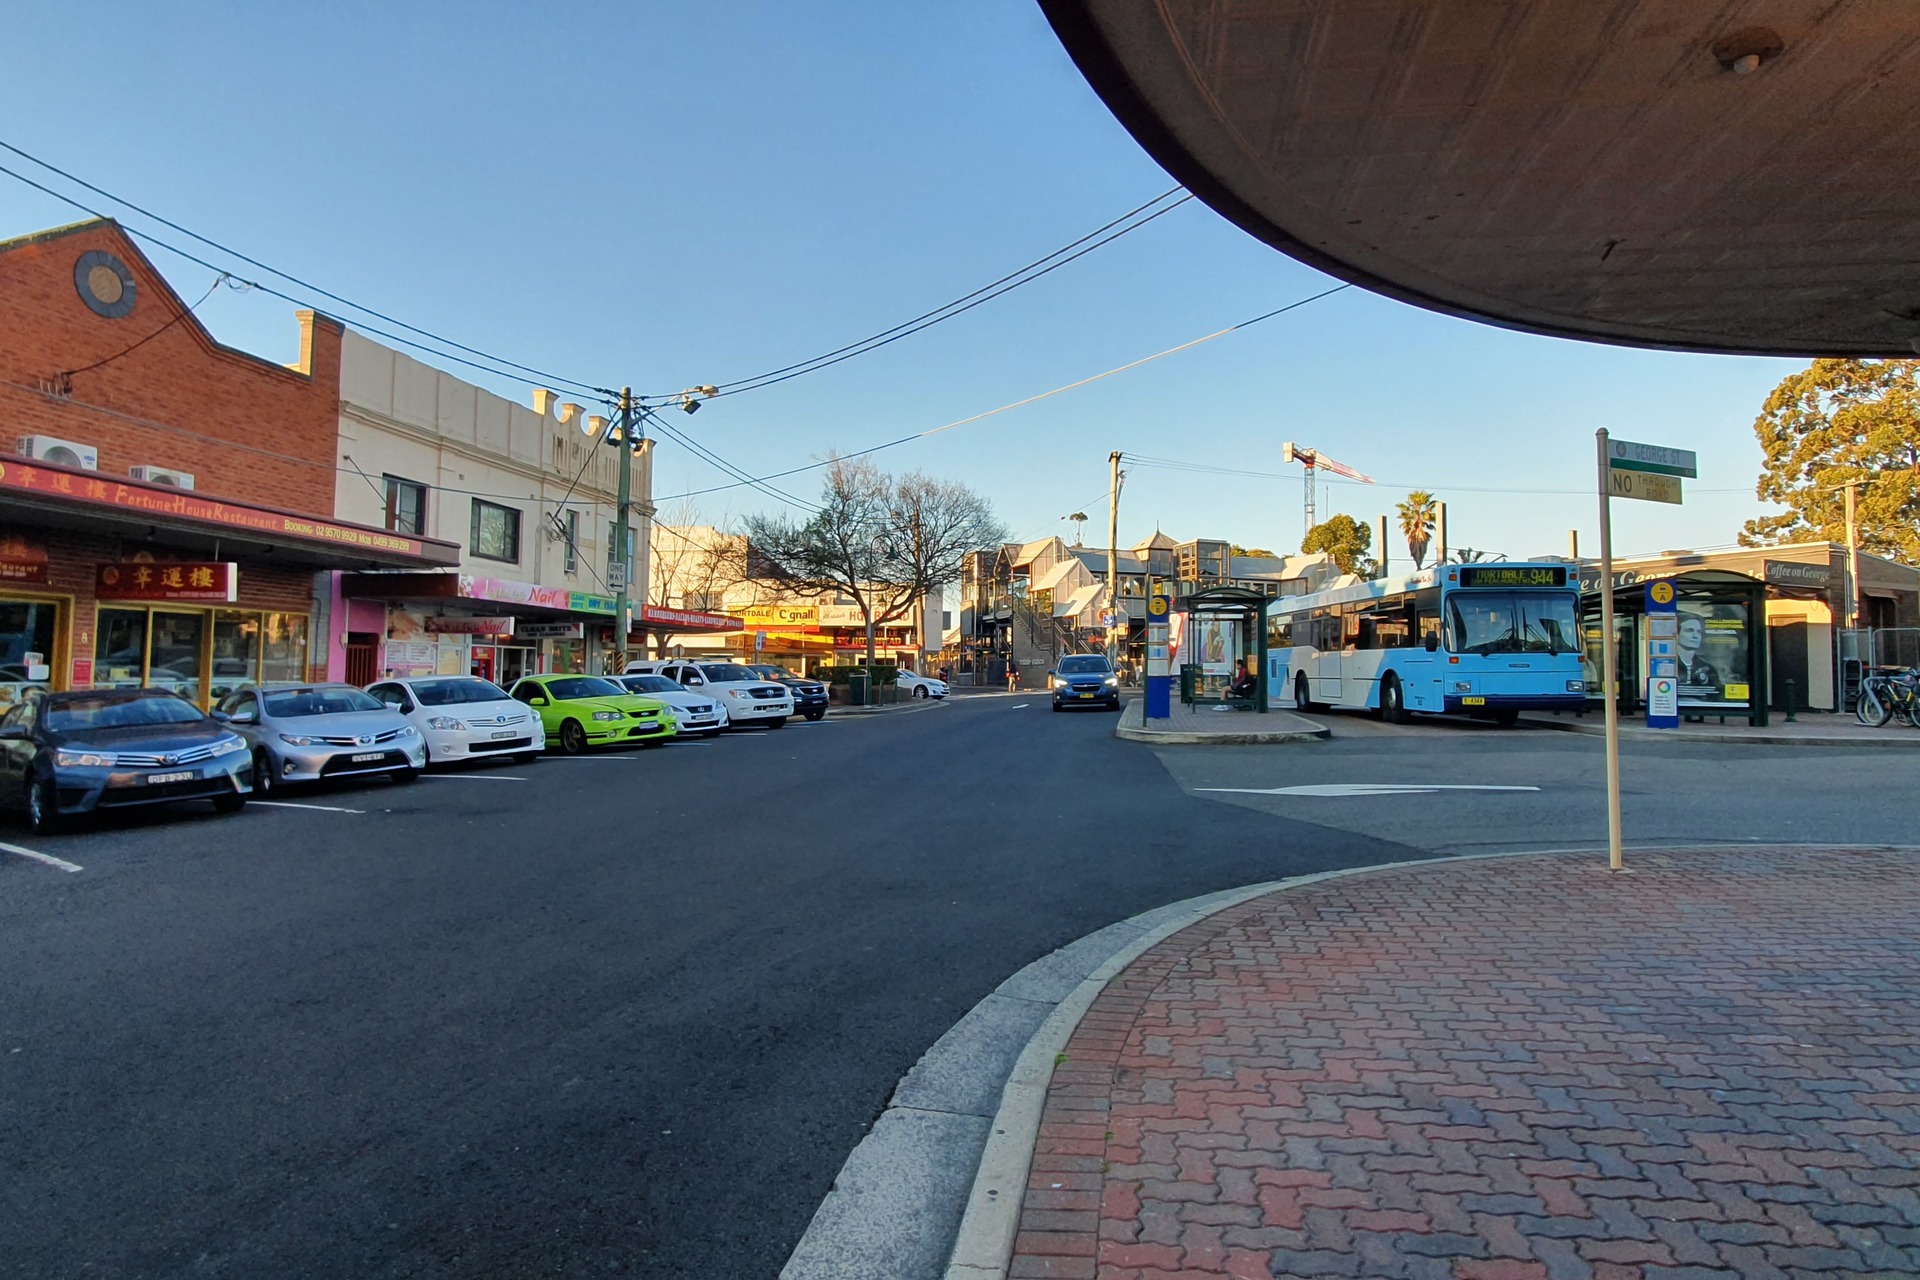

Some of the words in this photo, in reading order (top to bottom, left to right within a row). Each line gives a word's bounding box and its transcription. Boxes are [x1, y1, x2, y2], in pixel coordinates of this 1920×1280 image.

[1635, 445, 1668, 463] GEORGE
[1671, 450, 1680, 465] ST
[1613, 473, 1632, 493] NO
[1637, 475, 1677, 489] THROUGH
[1646, 488, 1670, 500] ROAD
[315, 525, 324, 536] 02
[325, 527, 341, 538] 9570
[341, 530, 357, 542] 9929
[610, 564, 623, 572] ONE
[1765, 563, 1791, 578] Coffee
[1792, 569, 1801, 577] on
[1802, 567, 1829, 582] George
[1477, 569, 1526, 579] MORTDALE
[1531, 569, 1554, 584] 944
[528, 587, 558, 604] Nail
[1660, 593, 1667, 601] A
[589, 599, 600, 608] DRY
[480, 620, 507, 632] Nail
[82, 632, 88, 643] 8
